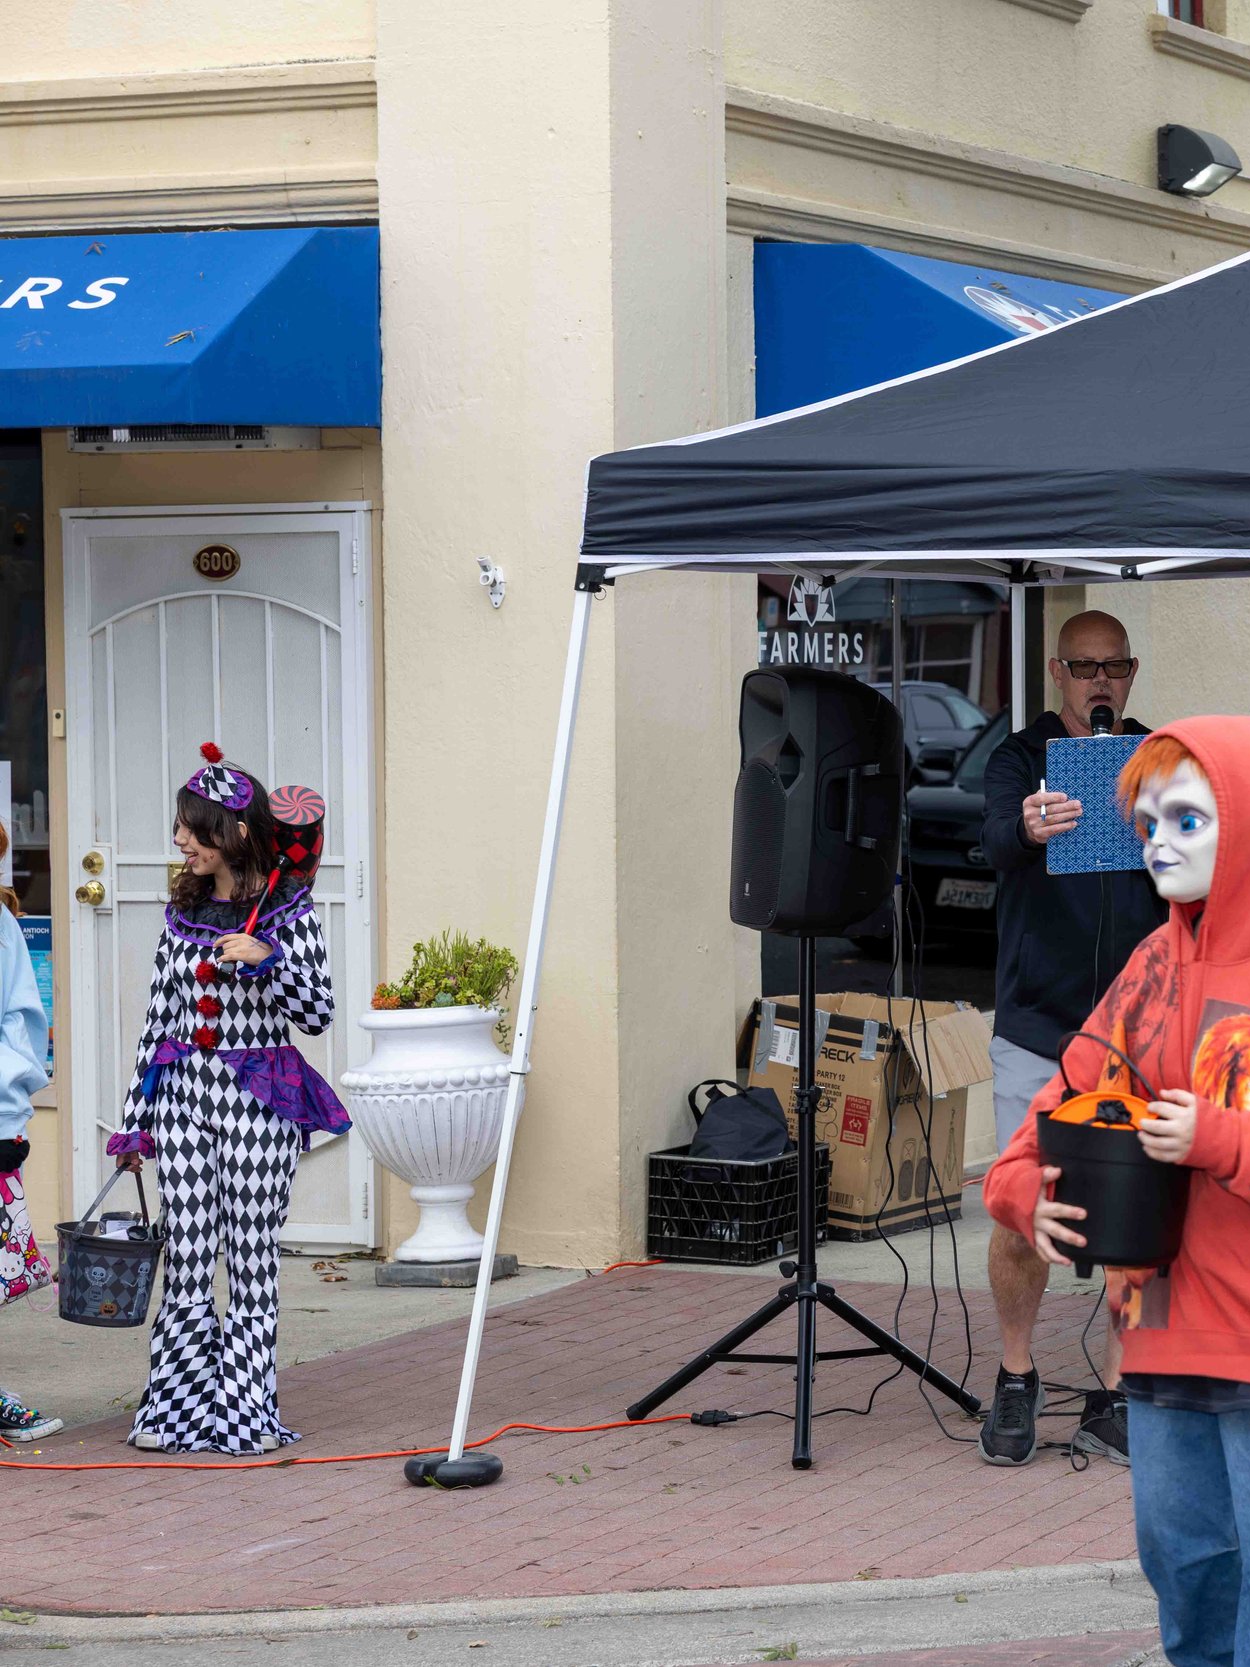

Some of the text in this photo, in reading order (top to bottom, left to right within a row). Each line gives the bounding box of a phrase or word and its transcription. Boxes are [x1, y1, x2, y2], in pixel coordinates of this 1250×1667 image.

[0, 276, 130, 309] RS
[200, 552, 232, 571] 600
[757, 631, 863, 664] FARMERS
[819, 1046, 856, 1064] RECK
[816, 1069, 846, 1082] PARTY 12
